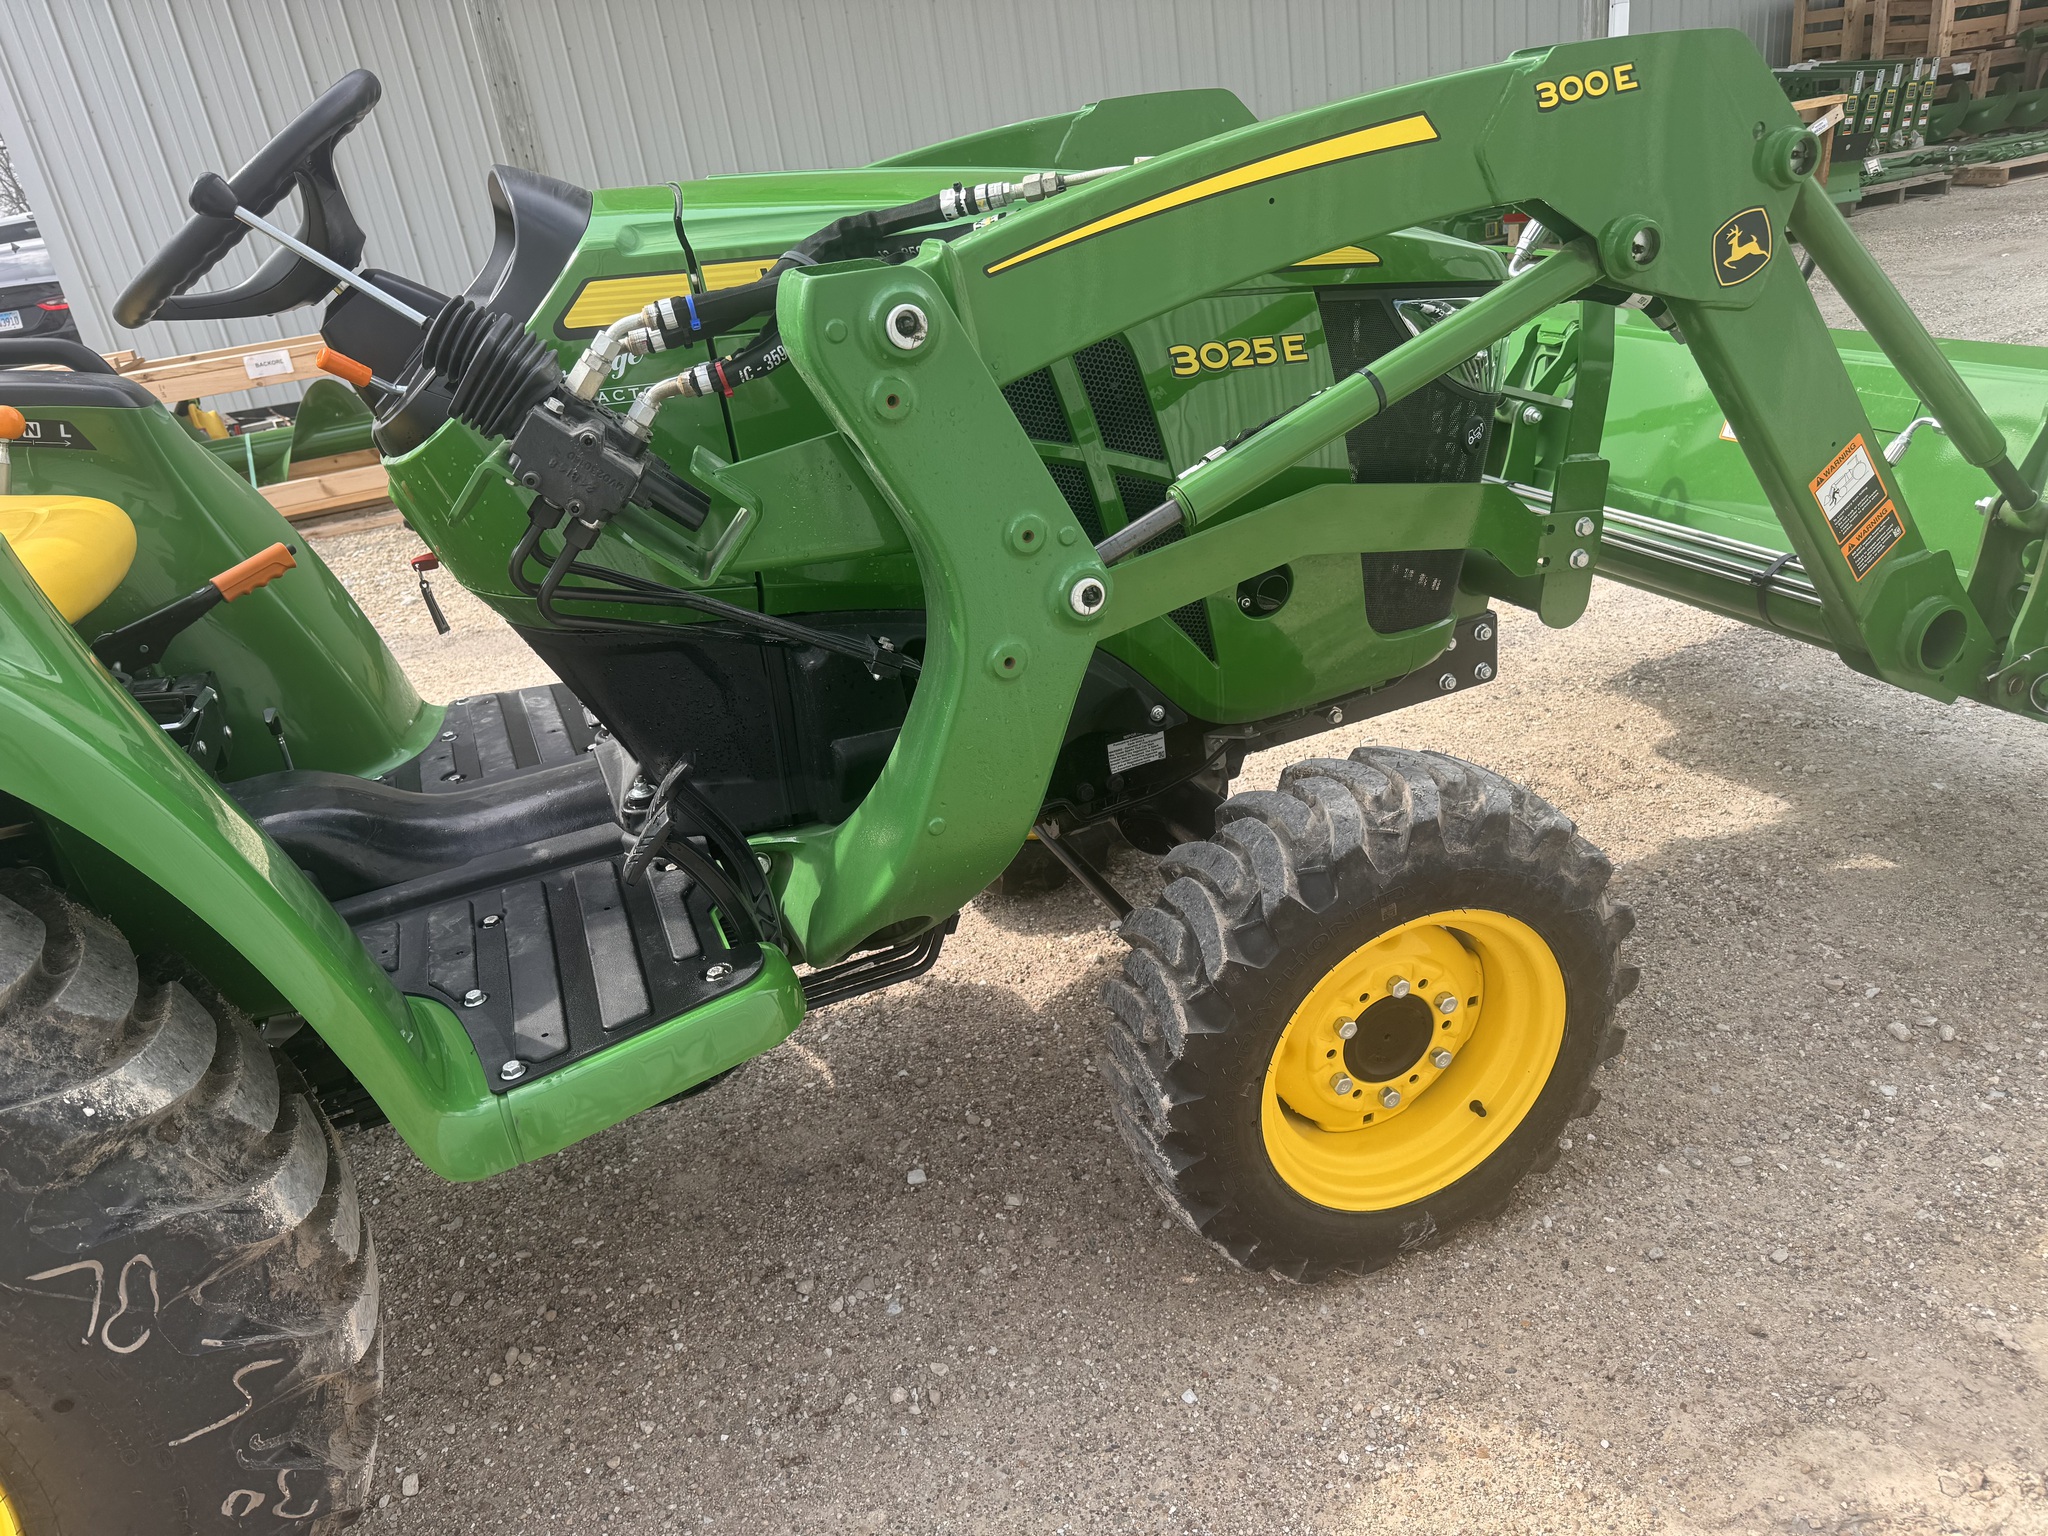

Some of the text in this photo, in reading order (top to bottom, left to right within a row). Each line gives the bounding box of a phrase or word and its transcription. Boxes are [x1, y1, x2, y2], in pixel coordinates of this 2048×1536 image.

[1168, 333, 1309, 377] 3025E
[25, 423, 72, 438] N L
[1823, 442, 1857, 478] WARNING
[1855, 507, 1888, 542] WARNING
